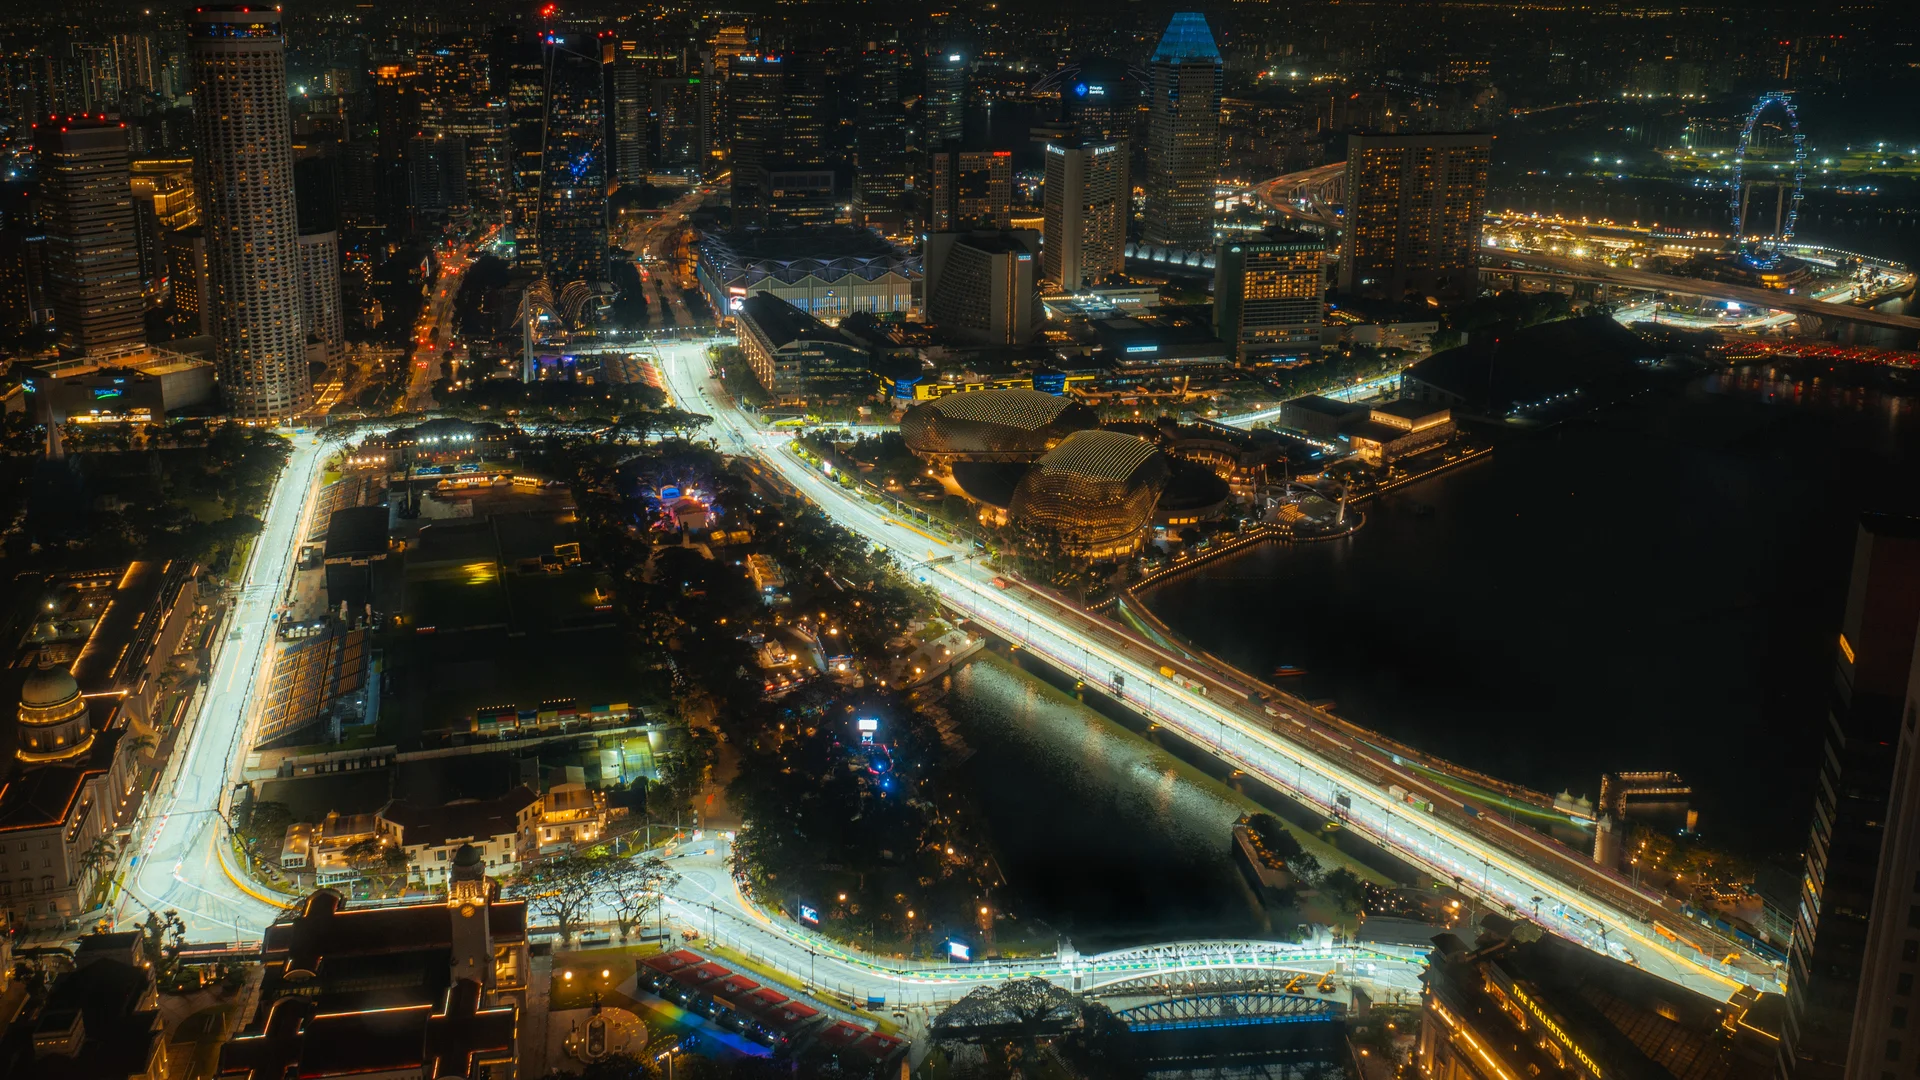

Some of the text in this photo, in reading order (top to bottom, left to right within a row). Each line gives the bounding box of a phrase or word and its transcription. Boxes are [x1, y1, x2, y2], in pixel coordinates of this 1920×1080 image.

[1513, 984, 1601, 1079] THE FULLERTON HOTEL
